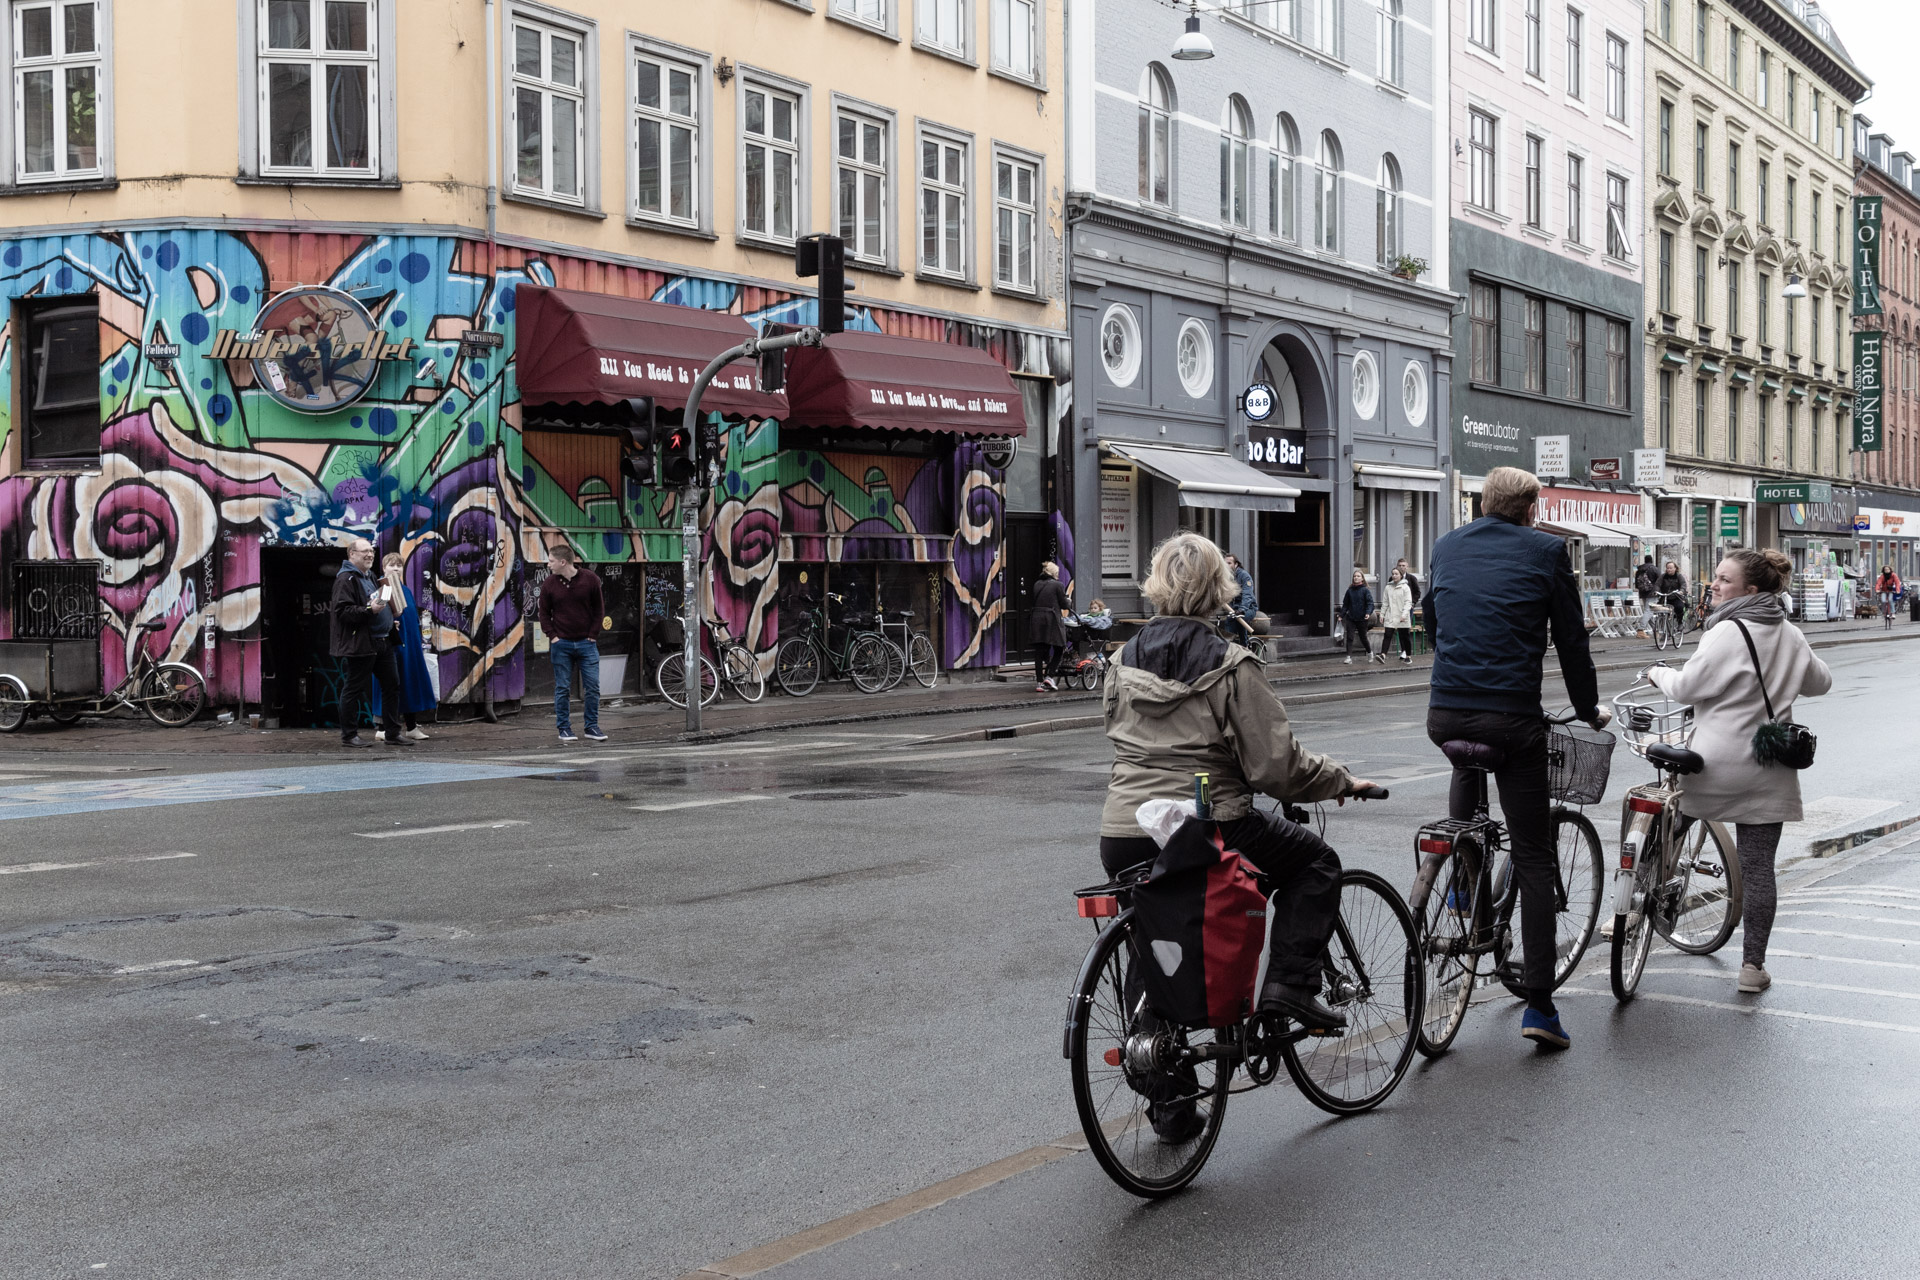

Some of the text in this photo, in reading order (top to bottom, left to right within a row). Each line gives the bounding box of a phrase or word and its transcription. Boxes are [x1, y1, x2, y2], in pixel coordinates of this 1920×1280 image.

[1858, 203, 1878, 309] HOTEL
[146, 344, 179, 356] Fælledvej
[600, 357, 619, 376] All
[623, 359, 642, 379] You
[647, 363, 674, 383] Need
[678, 366, 689, 384] Is
[734, 374, 752, 391] and
[870, 388, 886, 404] All
[887, 390, 904, 406] You
[905, 391, 927, 408] Need
[928, 393, 938, 408] Is
[968, 397, 981, 412] and
[1862, 338, 1880, 444] Hotel Nora
[1462, 415, 1520, 440] Greencubator
[982, 442, 1012, 451] TUBORG
[1265, 436, 1277, 463] &
[1280, 438, 1304, 465] Bar
[1673, 475, 1698, 487] KASSEN
[1764, 489, 1803, 499] HOTEL
[1550, 502, 1559, 523] of
[1560, 498, 1587, 524] KEBAB
[1588, 500, 1610, 525] PIZZA
[1612, 502, 1618, 525] &
[1620, 503, 1640, 526] GRILL
[1805, 502, 1848, 525] MALING.DK
